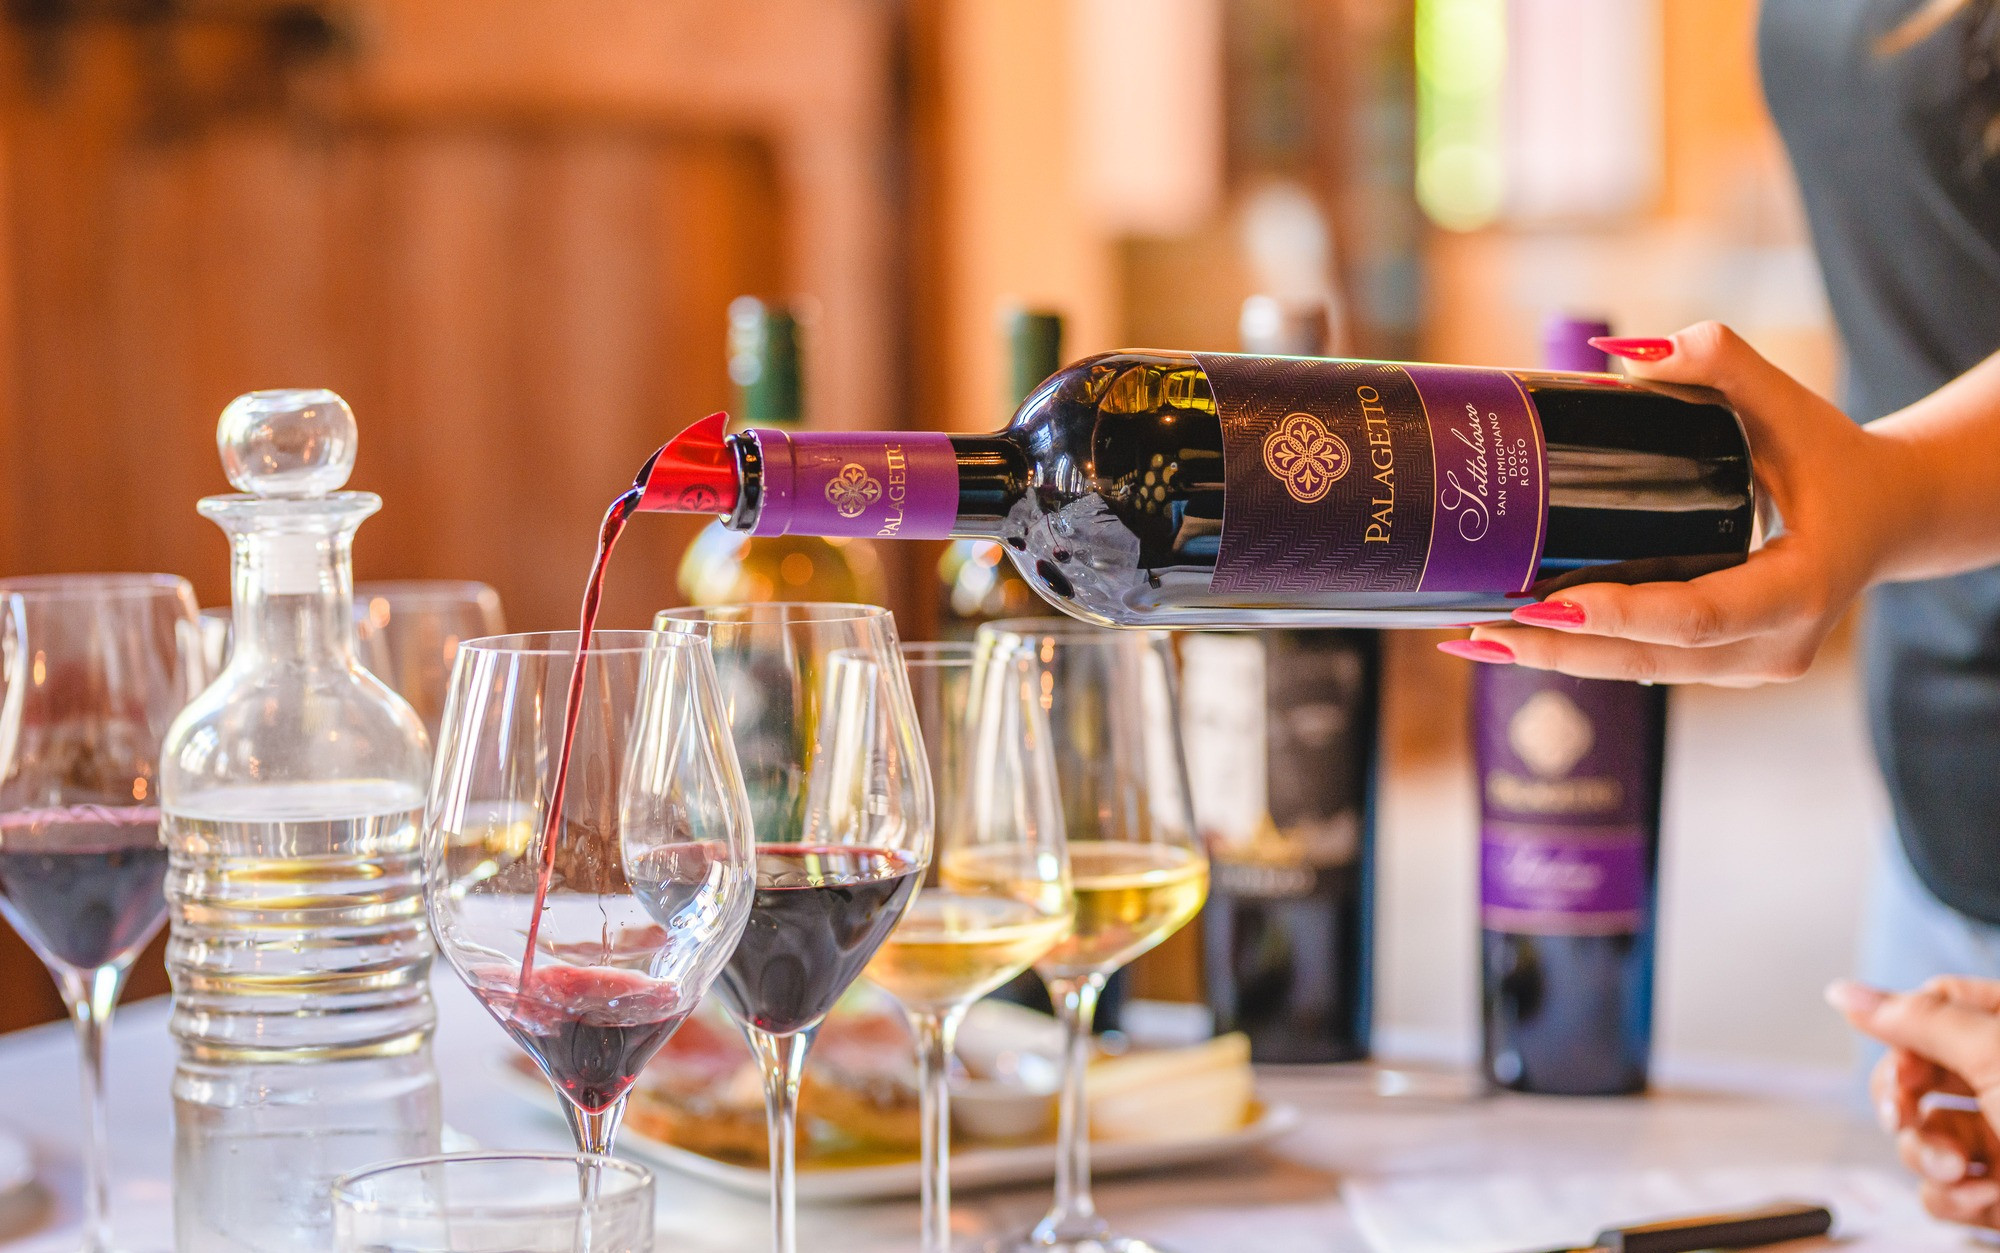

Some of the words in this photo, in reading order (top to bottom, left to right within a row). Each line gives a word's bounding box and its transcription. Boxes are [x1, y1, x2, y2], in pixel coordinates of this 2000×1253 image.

[1356, 385, 1395, 544] PALAGETTO
[1441, 402, 1489, 541] Sottobosco
[1488, 412, 1507, 485] GIMIGNANO
[1507, 444, 1517, 477] D.O.C.
[1517, 438, 1529, 486] ROSSO
[1496, 490, 1506, 516] SAN
